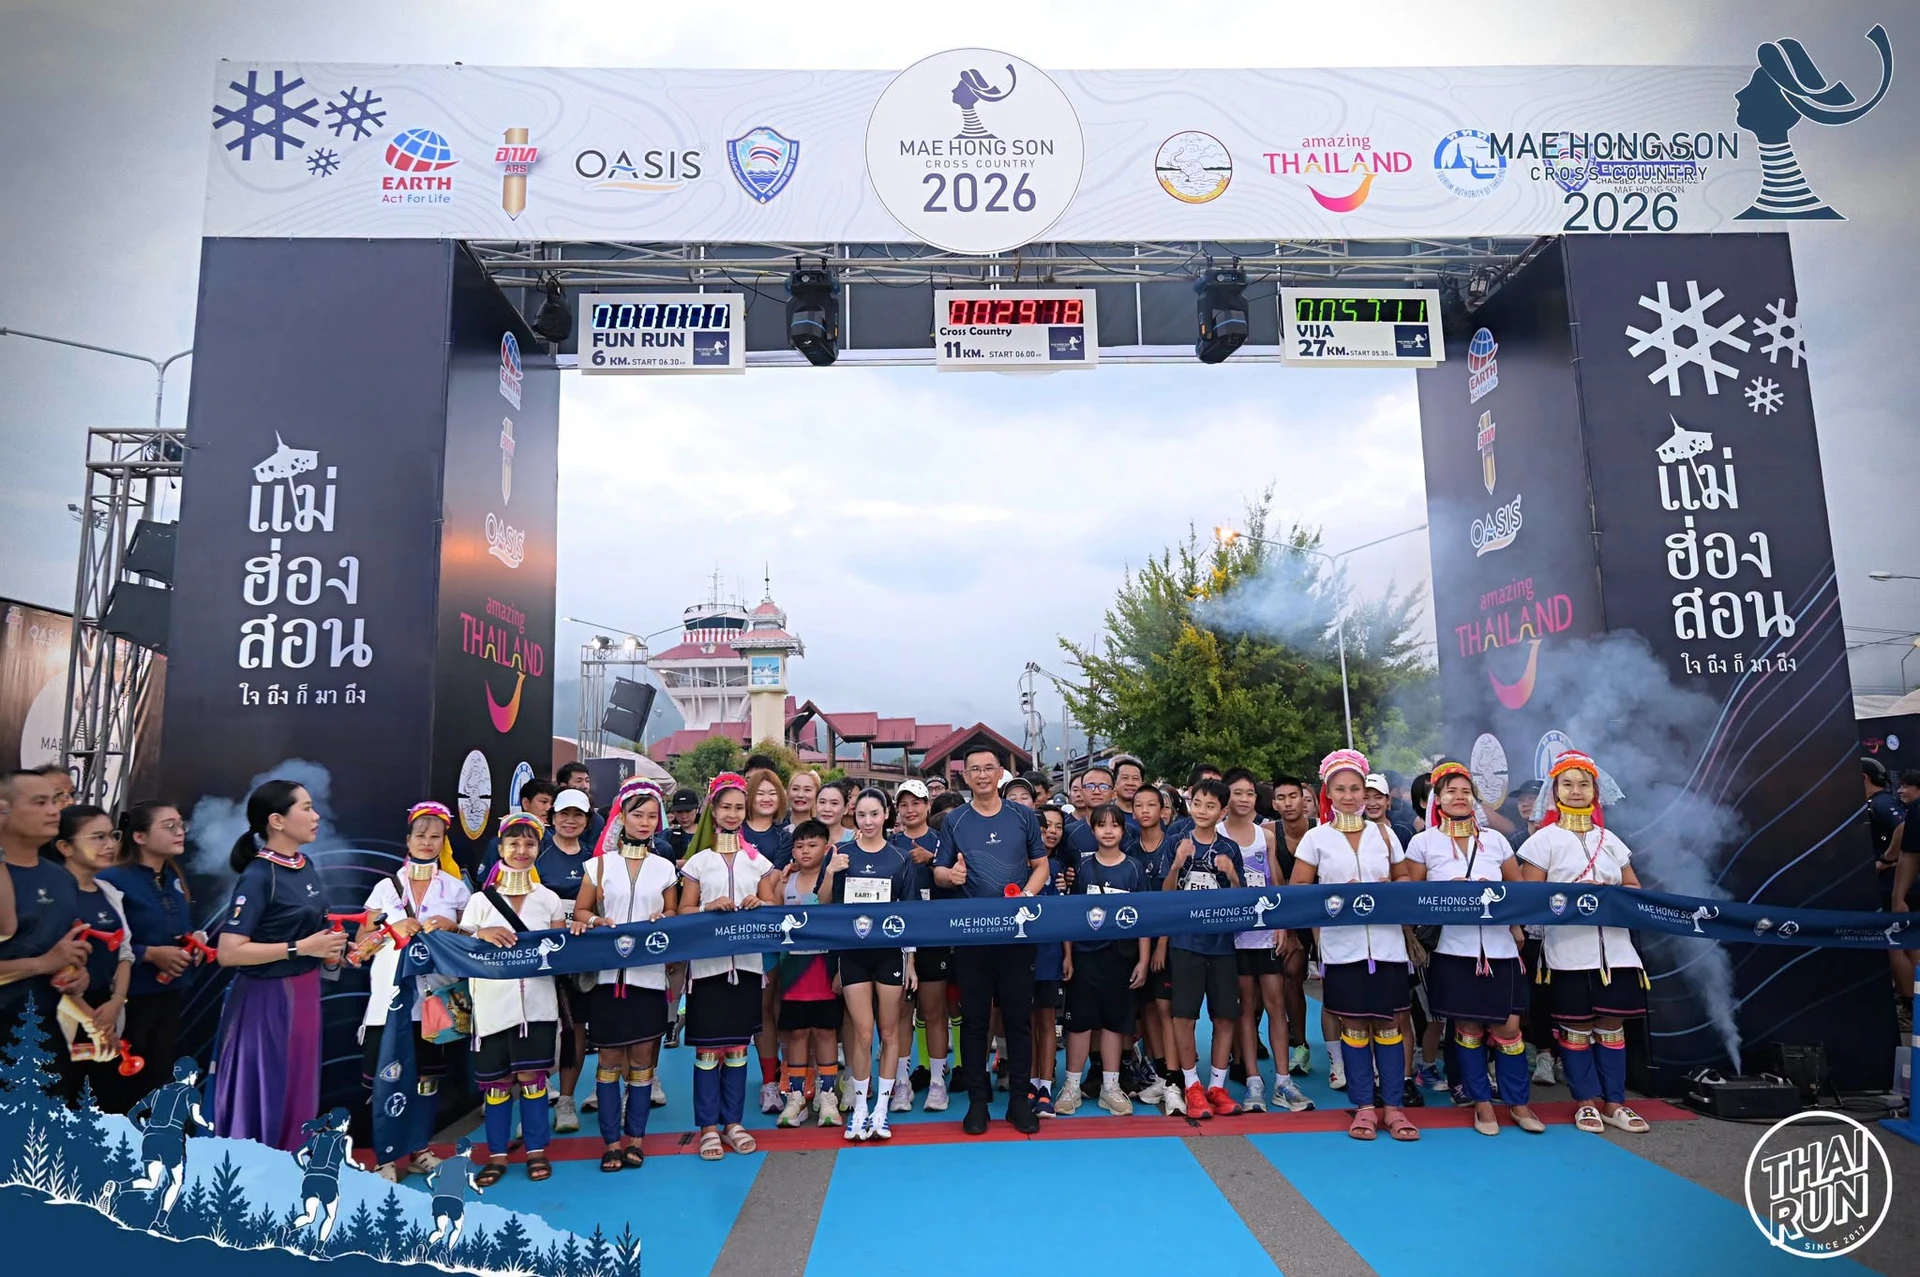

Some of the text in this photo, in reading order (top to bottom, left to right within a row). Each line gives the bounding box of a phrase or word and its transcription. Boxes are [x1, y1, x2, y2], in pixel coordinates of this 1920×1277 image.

[900, 139, 1054, 156] MAE HONG SON
[1301, 134, 1371, 150] amazing
[495, 147, 539, 162] อาท
[1262, 152, 1412, 174] THAILAND
[504, 164, 527, 173] ARS
[575, 150, 701, 179] OASIS
[925, 159, 1035, 168] CROSS COUNTRY
[382, 177, 452, 190] EARTH
[382, 194, 451, 203] Act For Life
[922, 172, 1037, 213] 2026
[592, 332, 685, 347] FUN RUN
[939, 326, 1012, 338] Cross Country
[1296, 324, 1335, 338] VIJA
[944, 341, 961, 358] 11
[963, 349, 984, 358] KM.
[1298, 339, 1327, 357] 27
[1327, 346, 1350, 356] KM.
[591, 350, 606, 366] 6
[610, 357, 631, 366] KM.
[632, 358, 657, 366] START
[659, 358, 680, 366] 06.30
[1470, 364, 1496, 391] EARTH
[1658, 446, 1739, 511] แม่
[248, 466, 338, 533] แม่
[1471, 502, 1522, 549] OASIS
[486, 513, 525, 562] OASIS
[1665, 515, 1772, 581] ฮ่อง
[243, 537, 359, 606] ฮ่อง
[1480, 577, 1534, 611] amazing
[486, 597, 525, 634] amazing
[1672, 587, 1796, 640] สอน
[1455, 594, 1574, 658] THAILAND
[238, 613, 373, 669] สอน
[460, 612, 544, 677] THAILAND
[1750, 657, 1771, 672] มา
[315, 689, 338, 705] มา
[1418, 896, 1484, 906] MAE HONG SO
[1190, 906, 1258, 919] MAE HONG SO
[1637, 902, 1694, 919] MAE HONG SO
[715, 923, 783, 936] MAE HONG SO
[949, 916, 1018, 928] MAE HONG SO
[492, 950, 523, 960] HONG
[525, 947, 541, 957] SO
[507, 958, 538, 966] COUNTRY
